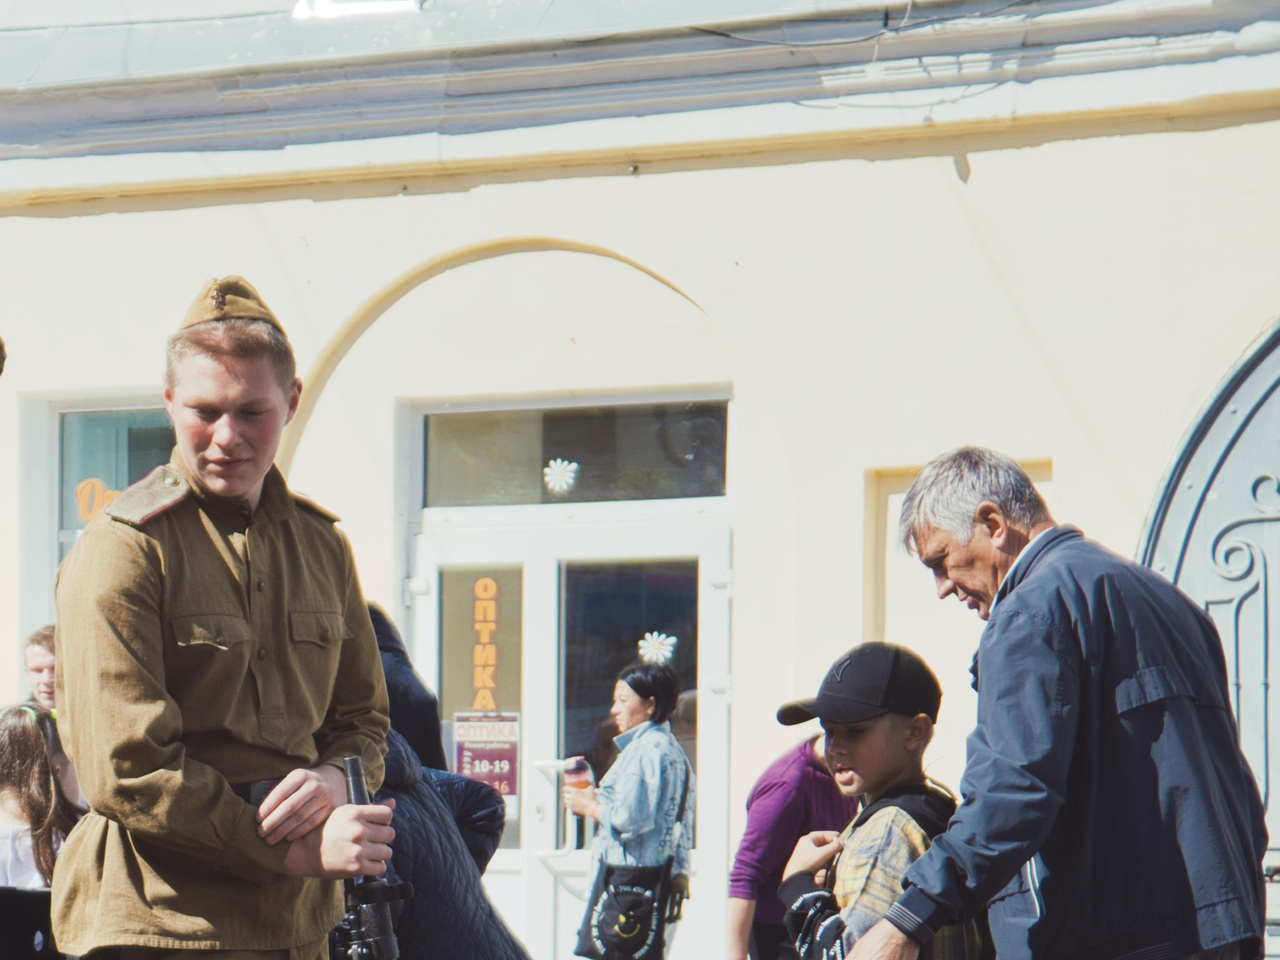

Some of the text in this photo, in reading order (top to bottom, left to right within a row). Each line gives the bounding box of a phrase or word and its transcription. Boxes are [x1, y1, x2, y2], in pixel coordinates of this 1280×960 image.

[472, 577, 497, 710] ОПТИКА
[457, 724, 517, 738] ОПТИКА
[474, 759, 510, 773] 10-19
